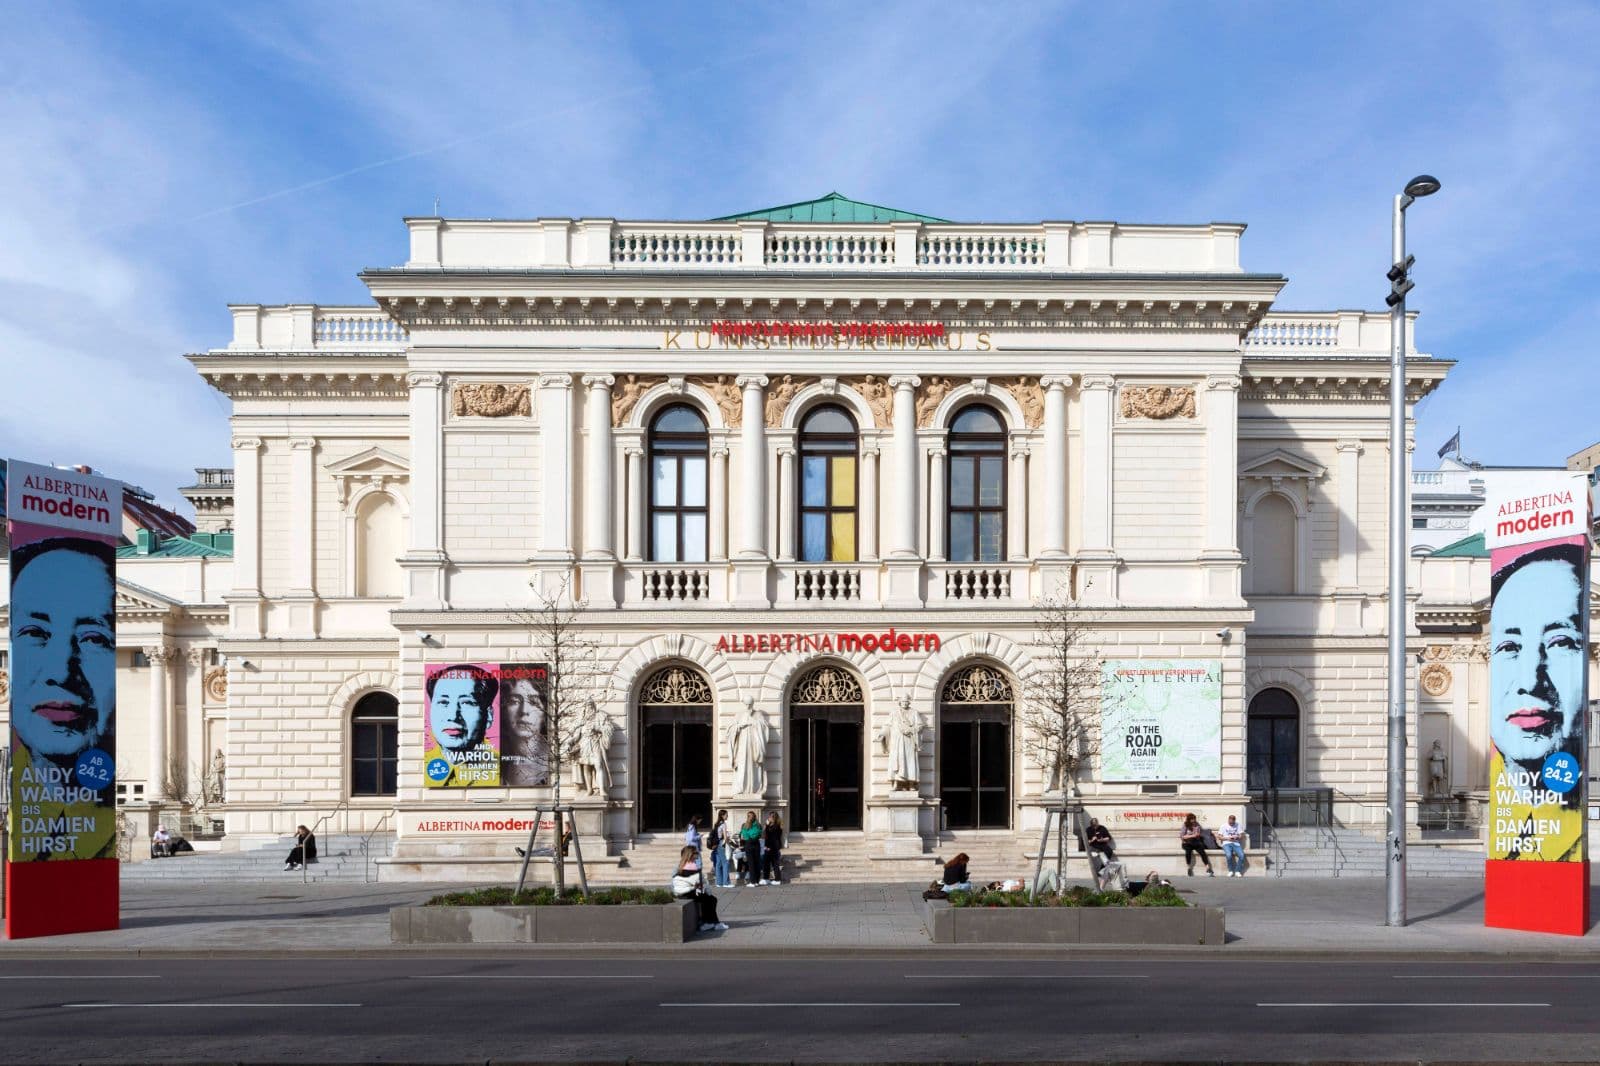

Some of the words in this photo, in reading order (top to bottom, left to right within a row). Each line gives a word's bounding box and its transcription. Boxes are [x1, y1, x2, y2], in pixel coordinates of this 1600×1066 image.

[23, 474, 109, 502] ALBERTINA
[22, 494, 110, 523] modern
[1497, 490, 1574, 516] ALBERTINA
[1497, 509, 1574, 536] modern
[715, 633, 834, 653] ALBERTINA
[837, 628, 941, 653] modern
[429, 669, 488, 680] ALBERTINA
[490, 665, 546, 679] modern
[1128, 726, 1141, 734] ON
[1143, 726, 1160, 734] THE
[1125, 735, 1163, 748] ROAD
[445, 751, 498, 762] WARHOL
[1130, 748, 1157, 757] AGAIN
[89, 756, 103, 766] AB
[1555, 759, 1569, 769] AB
[21, 767, 74, 783] ANDY
[78, 763, 110, 782] 24.2.
[459, 770, 497, 780] HIRST
[1496, 771, 1541, 788] ANDY
[1544, 767, 1575, 784] 24.2.
[21, 787, 103, 802] WARHOL
[1496, 789, 1569, 805] WARHOL
[21, 805, 41, 815] BIS
[1496, 807, 1512, 817] BIS
[21, 817, 96, 834] DAMIEN
[417, 821, 480, 832] ALBERTINA
[1496, 819, 1561, 835] DAMIEN
[21, 836, 79, 853] HIRST
[1496, 836, 1545, 853] HIRST
